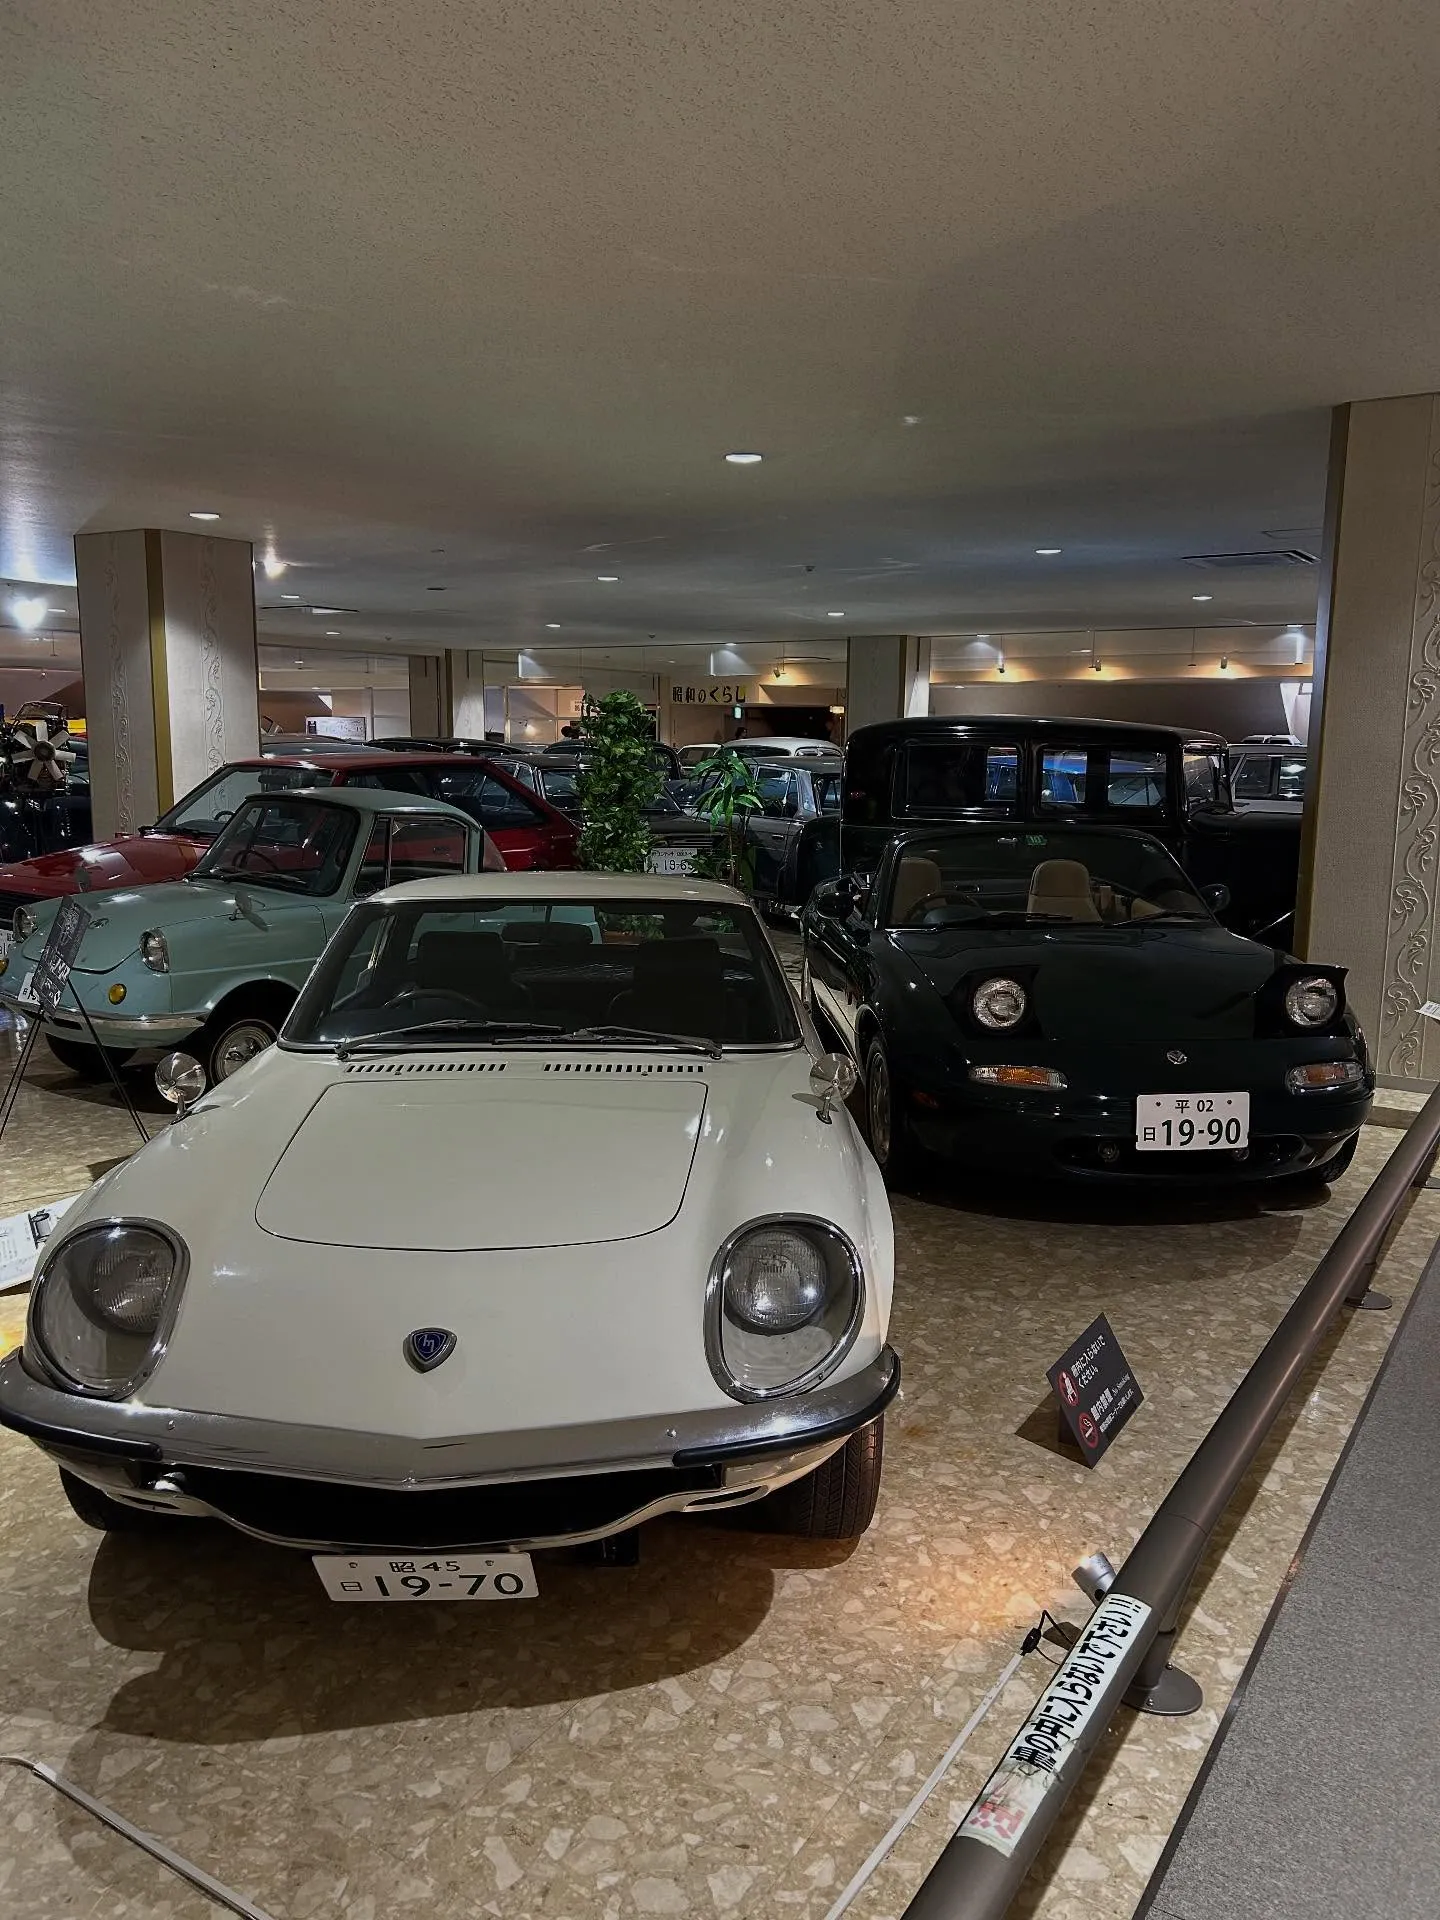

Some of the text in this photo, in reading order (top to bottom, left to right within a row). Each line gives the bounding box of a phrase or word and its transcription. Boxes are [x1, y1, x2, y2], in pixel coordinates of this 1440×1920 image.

[672, 685, 746, 703] 昭和のくらし
[1175, 1100, 1214, 1113] 平 02
[1143, 1118, 1241, 1146] 日 19-90
[340, 1572, 524, 1598] 日 19-70
